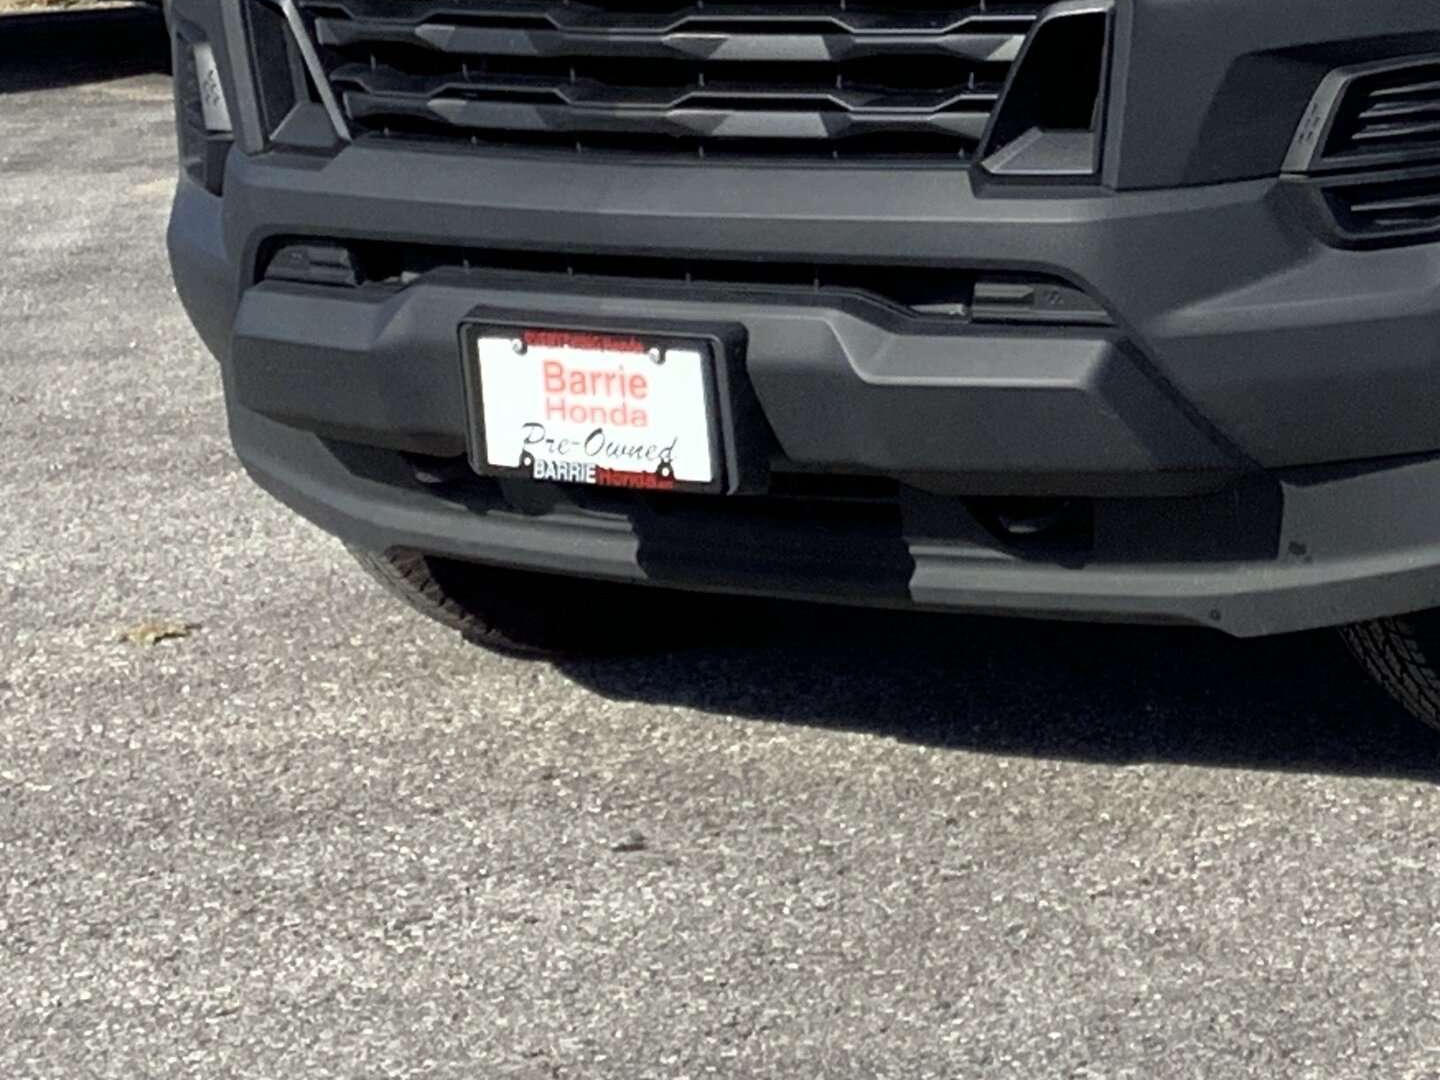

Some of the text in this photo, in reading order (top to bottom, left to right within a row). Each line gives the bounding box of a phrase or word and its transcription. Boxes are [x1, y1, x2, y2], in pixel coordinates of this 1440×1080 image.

[542, 360, 648, 399] Barrie
[545, 396, 649, 428] Honda
[522, 422, 679, 463] Pre-Owned
[533, 458, 597, 484] BARRIE
